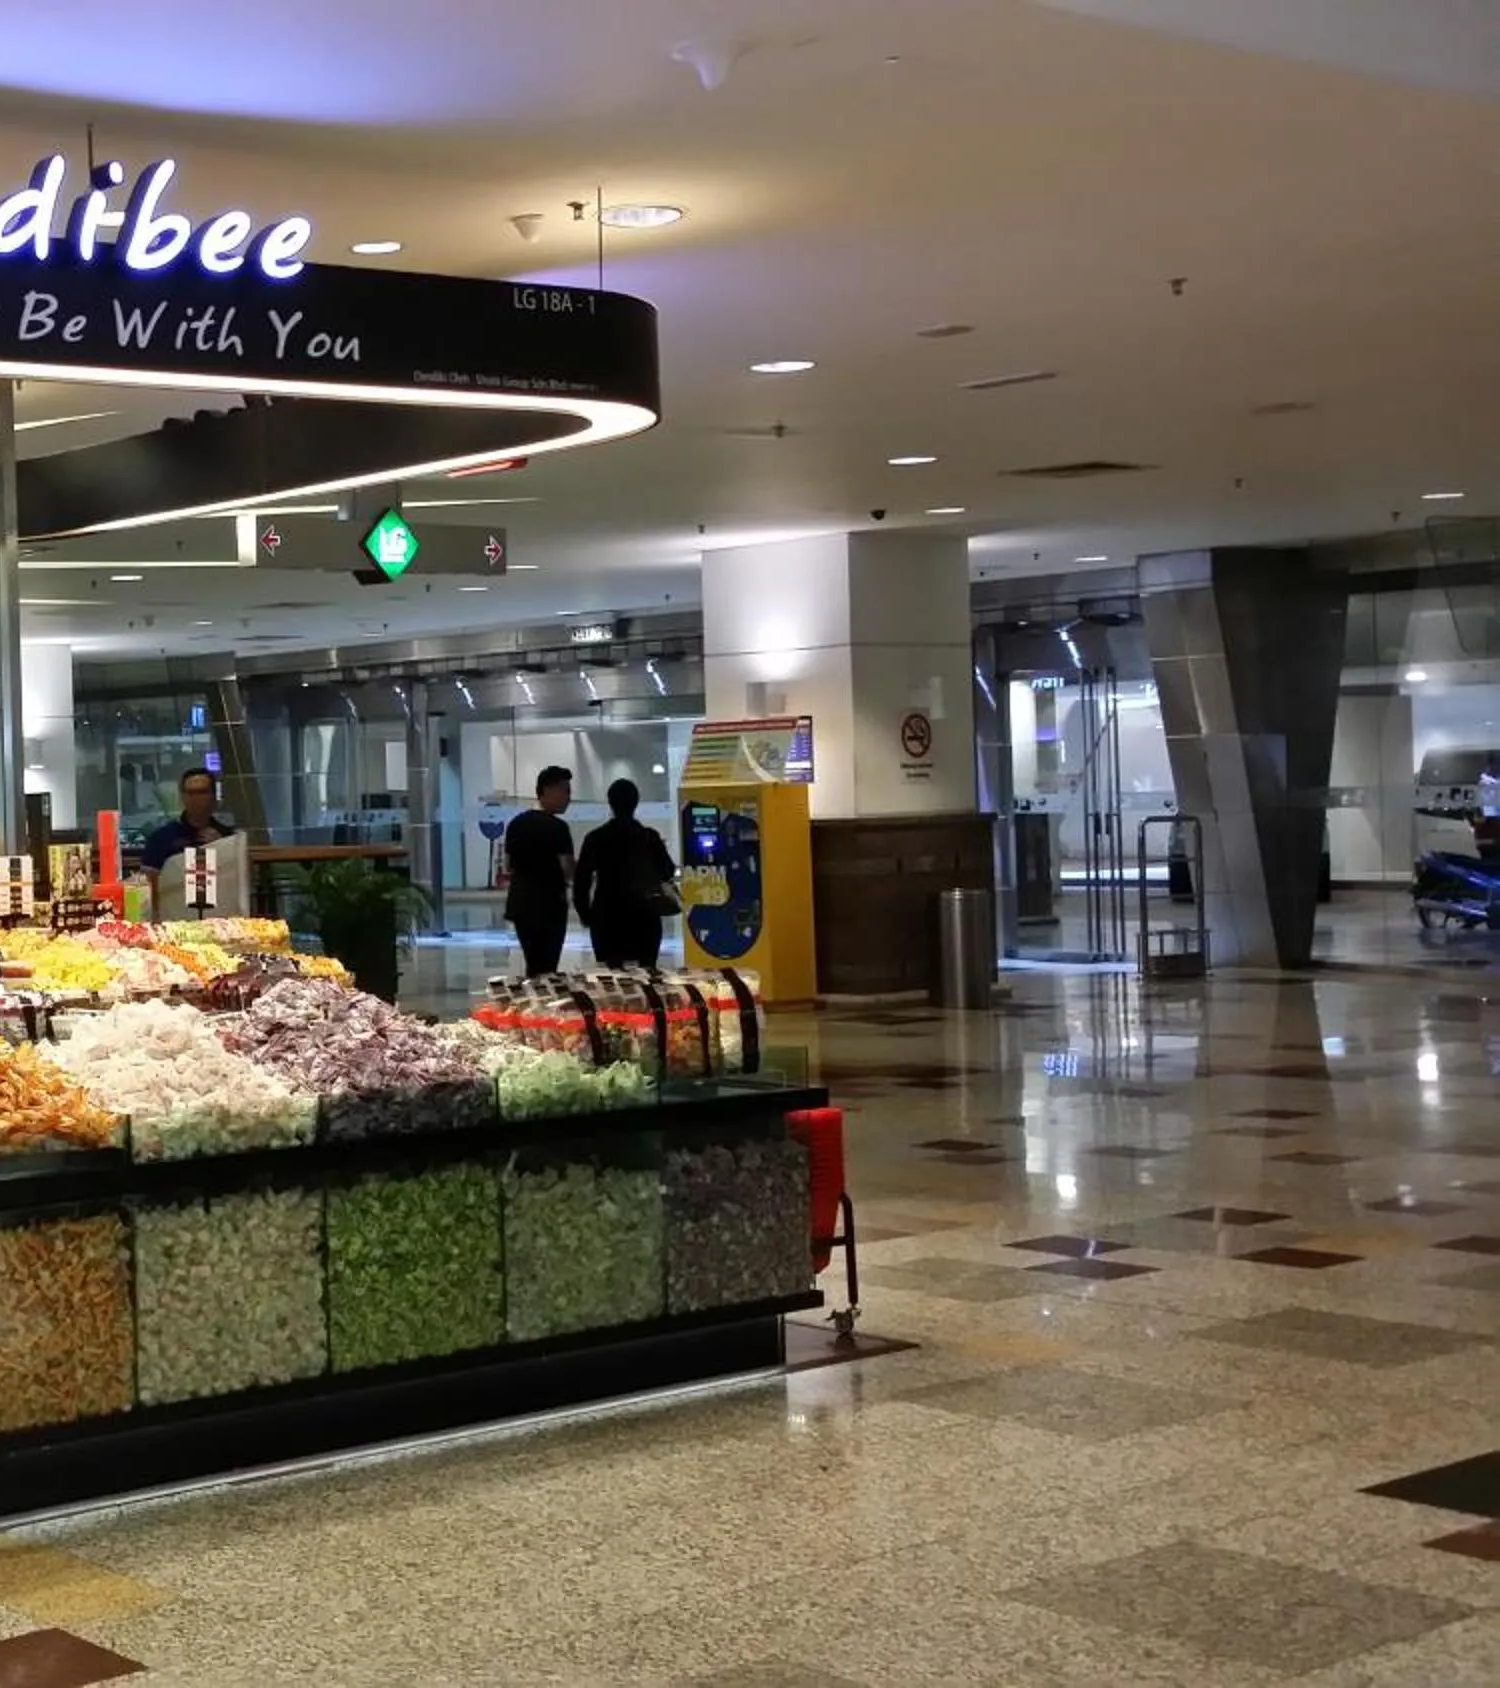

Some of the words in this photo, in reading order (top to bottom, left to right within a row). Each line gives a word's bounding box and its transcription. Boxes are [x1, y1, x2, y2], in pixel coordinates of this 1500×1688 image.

[513, 288, 537, 310] LG
[542, 291, 573, 314] 18A
[18, 290, 88, 343] Be
[113, 298, 245, 357] With
[267, 308, 361, 362] You
